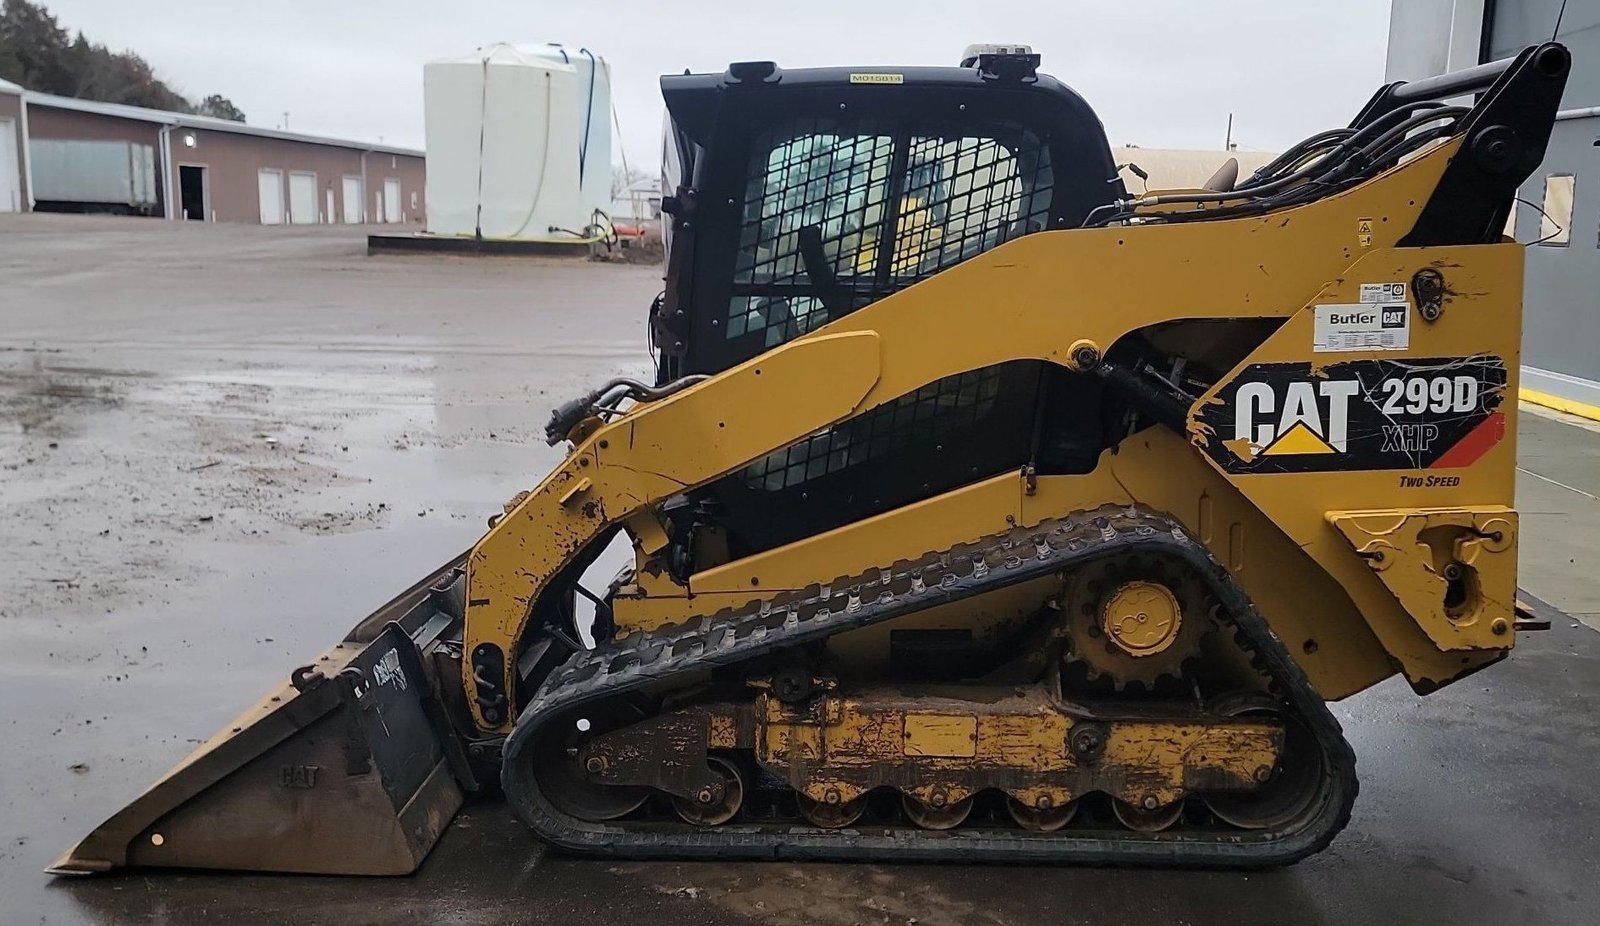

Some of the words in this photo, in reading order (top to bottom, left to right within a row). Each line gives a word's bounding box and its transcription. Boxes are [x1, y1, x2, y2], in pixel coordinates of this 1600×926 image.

[1330, 313, 1376, 324] Butler
[1383, 312, 1404, 324] CAT
[1381, 376, 1478, 415] 299D
[1235, 380, 1359, 454] CAT
[1381, 423, 1439, 452] XHP
[1425, 475, 1460, 487] SPEED
[279, 765, 319, 788] CAT
